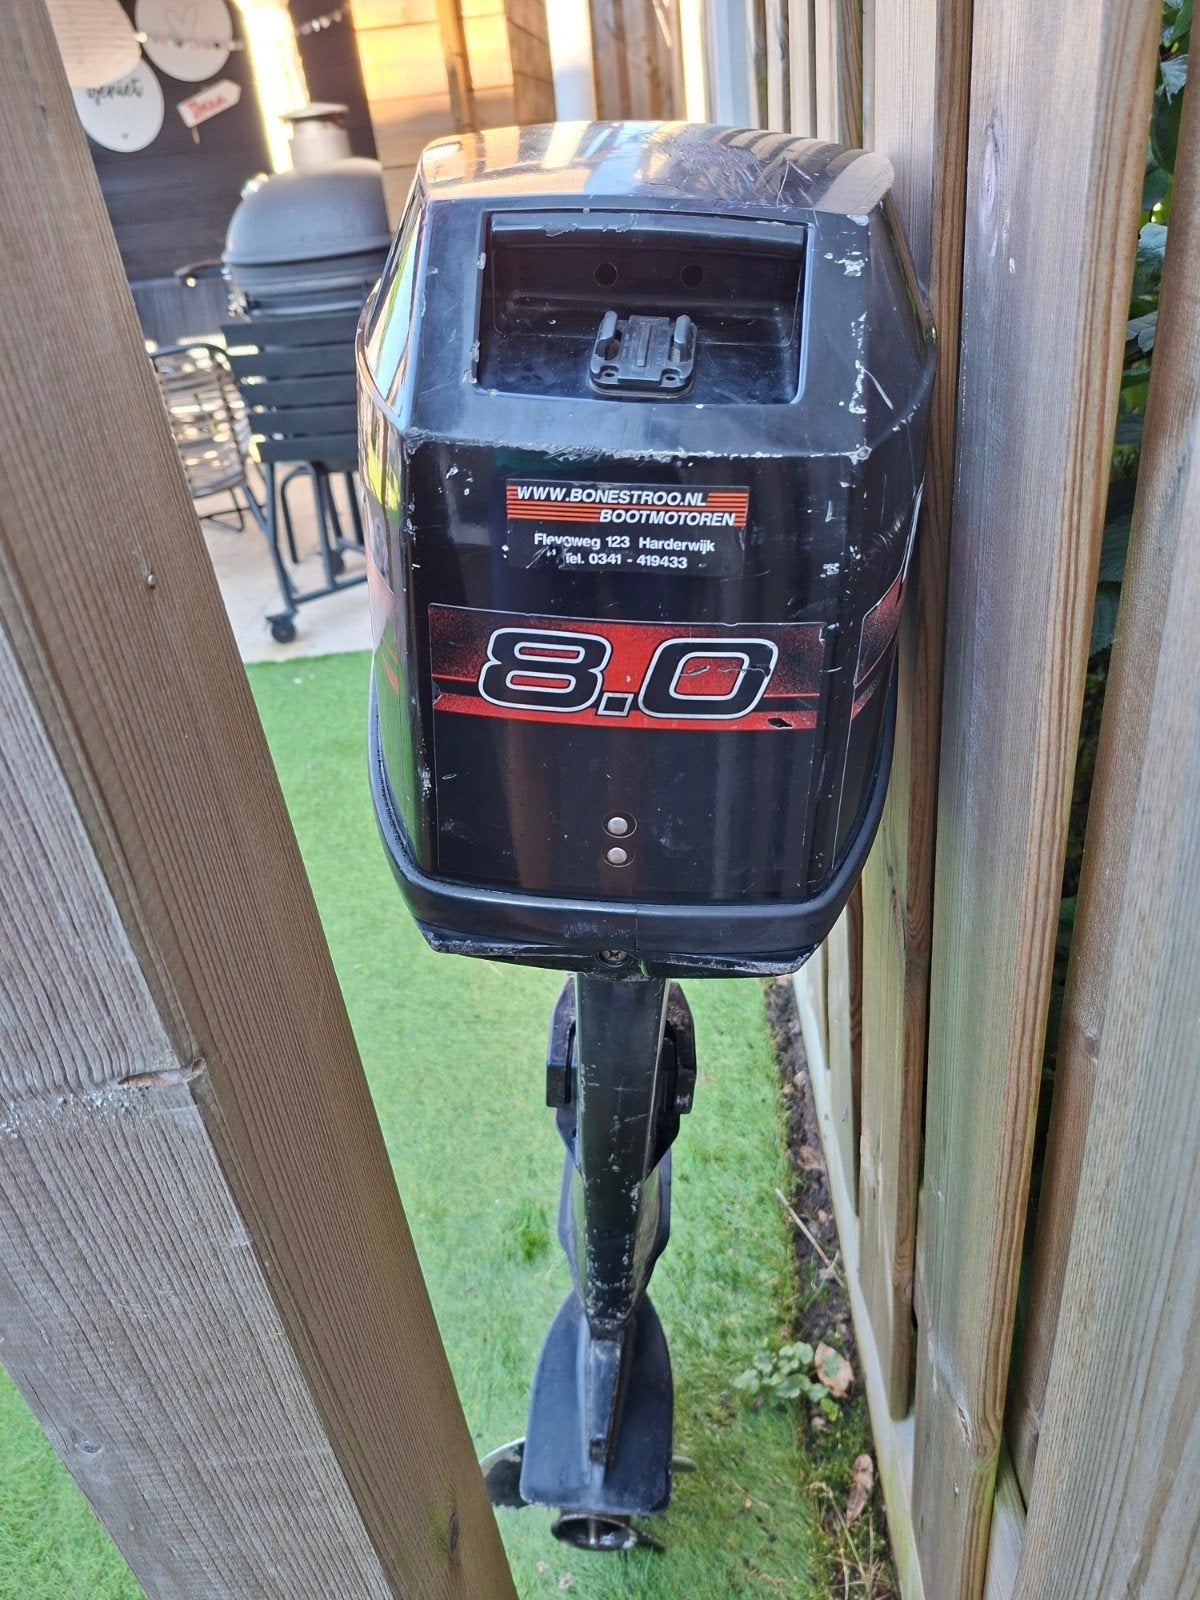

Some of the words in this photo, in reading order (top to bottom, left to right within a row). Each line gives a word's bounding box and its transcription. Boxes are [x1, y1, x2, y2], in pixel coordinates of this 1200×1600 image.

[516, 486, 708, 507] WWW.BONESTROO.NL
[599, 509, 736, 527] BOOTMOTOREN
[533, 532, 601, 550] Flevoweg
[605, 535, 631, 548] 123
[638, 536, 716, 555] Harderwijk
[564, 552, 585, 565] Tel.
[588, 553, 622, 565] 0341
[636, 553, 688, 569] 419433
[477, 627, 780, 720] 8.0
